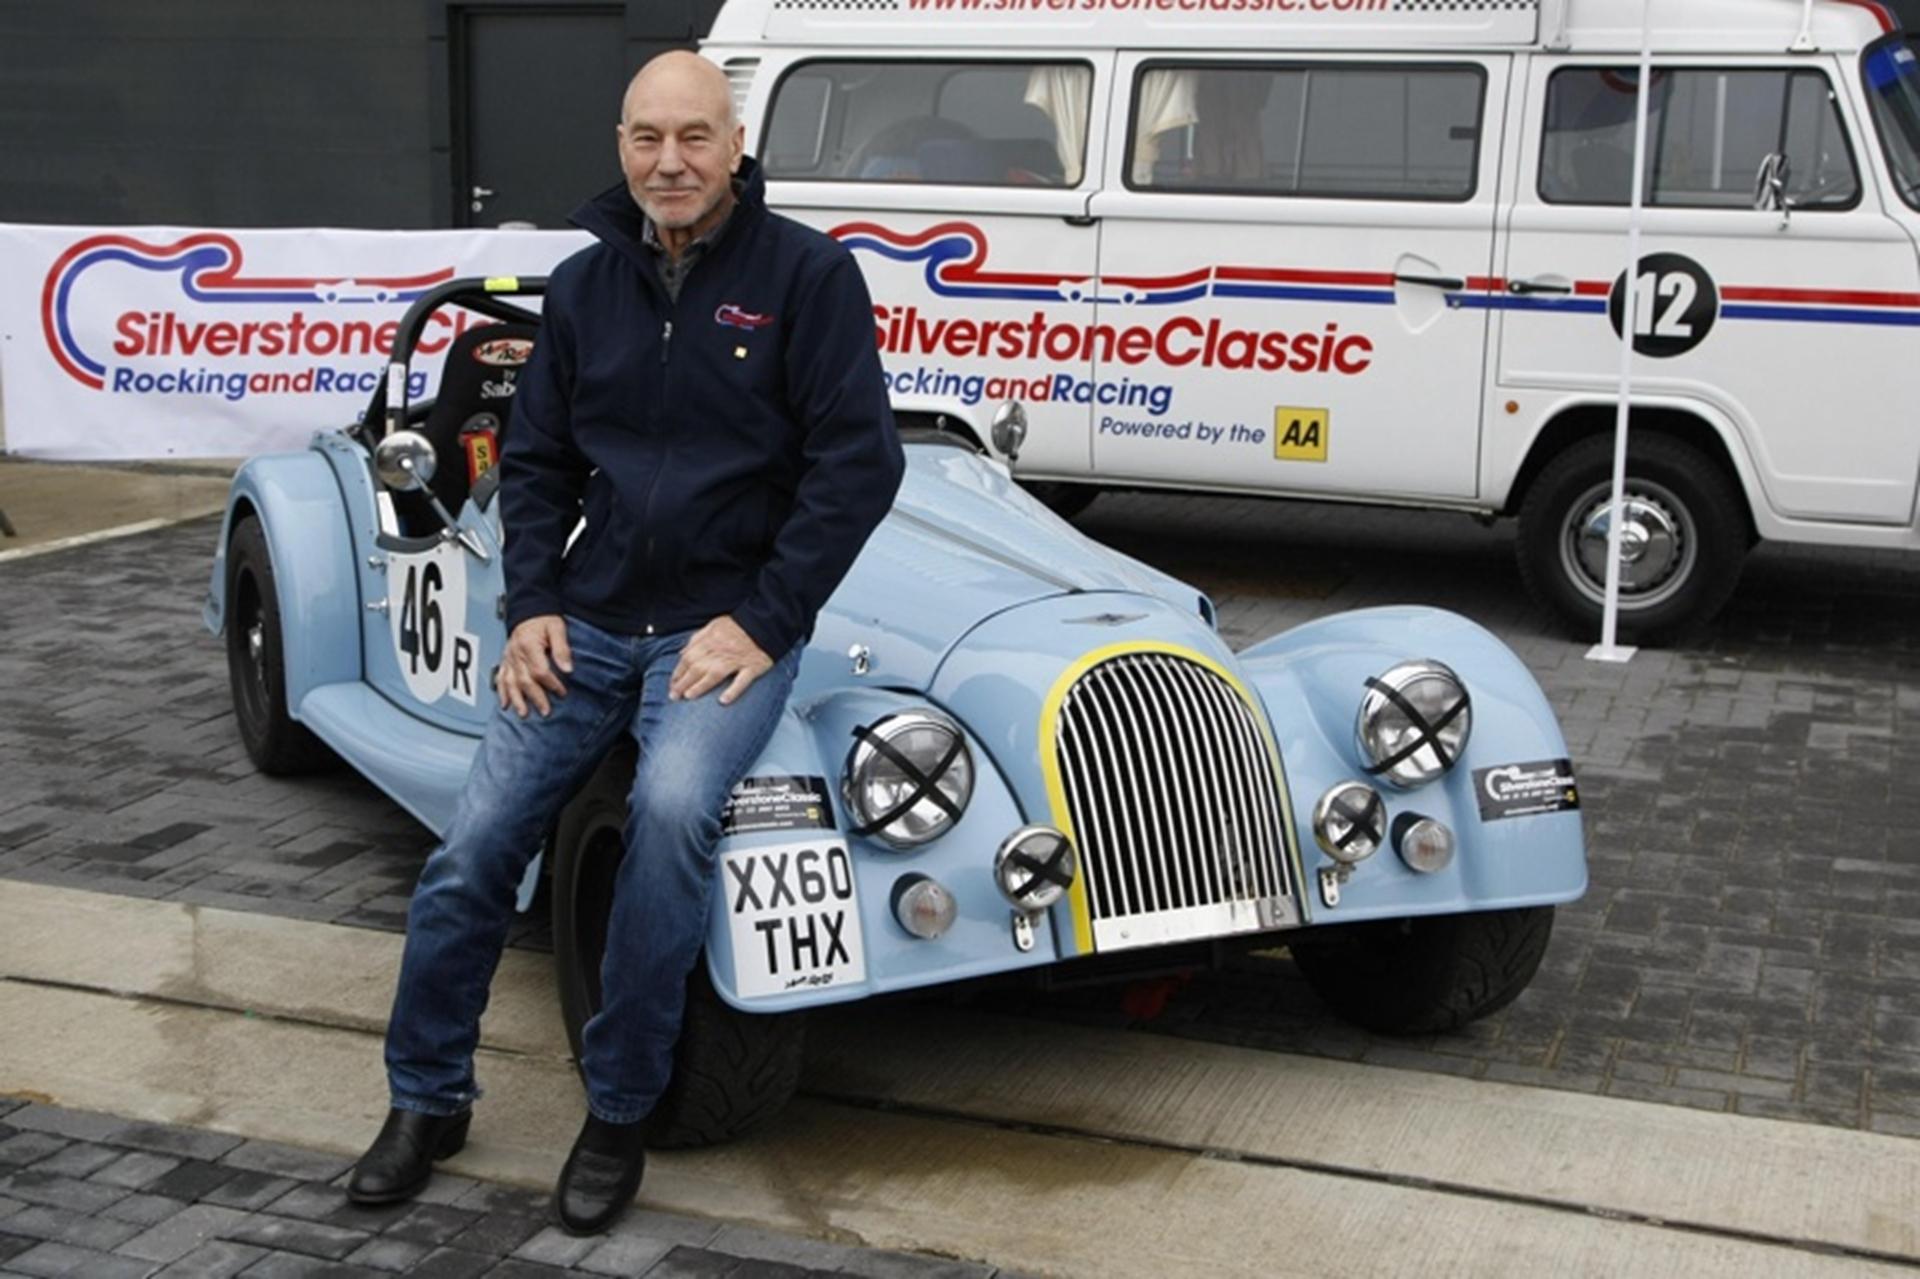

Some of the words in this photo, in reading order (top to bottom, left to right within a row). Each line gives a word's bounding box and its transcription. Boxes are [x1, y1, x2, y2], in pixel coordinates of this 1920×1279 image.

[113, 310, 503, 358] SilverstoneCl
[1633, 271, 1697, 337] 12
[113, 366, 428, 400] RockingandRacg
[881, 366, 1173, 415] ckingandRacing
[1099, 416, 1192, 440] Powered
[1196, 422, 1224, 445] by
[1230, 425, 1266, 444] the
[1281, 419, 1321, 448] AA
[400, 561, 443, 675] 46
[452, 636, 473, 696] R
[727, 846, 853, 914] XX60
[754, 910, 849, 975] THX
